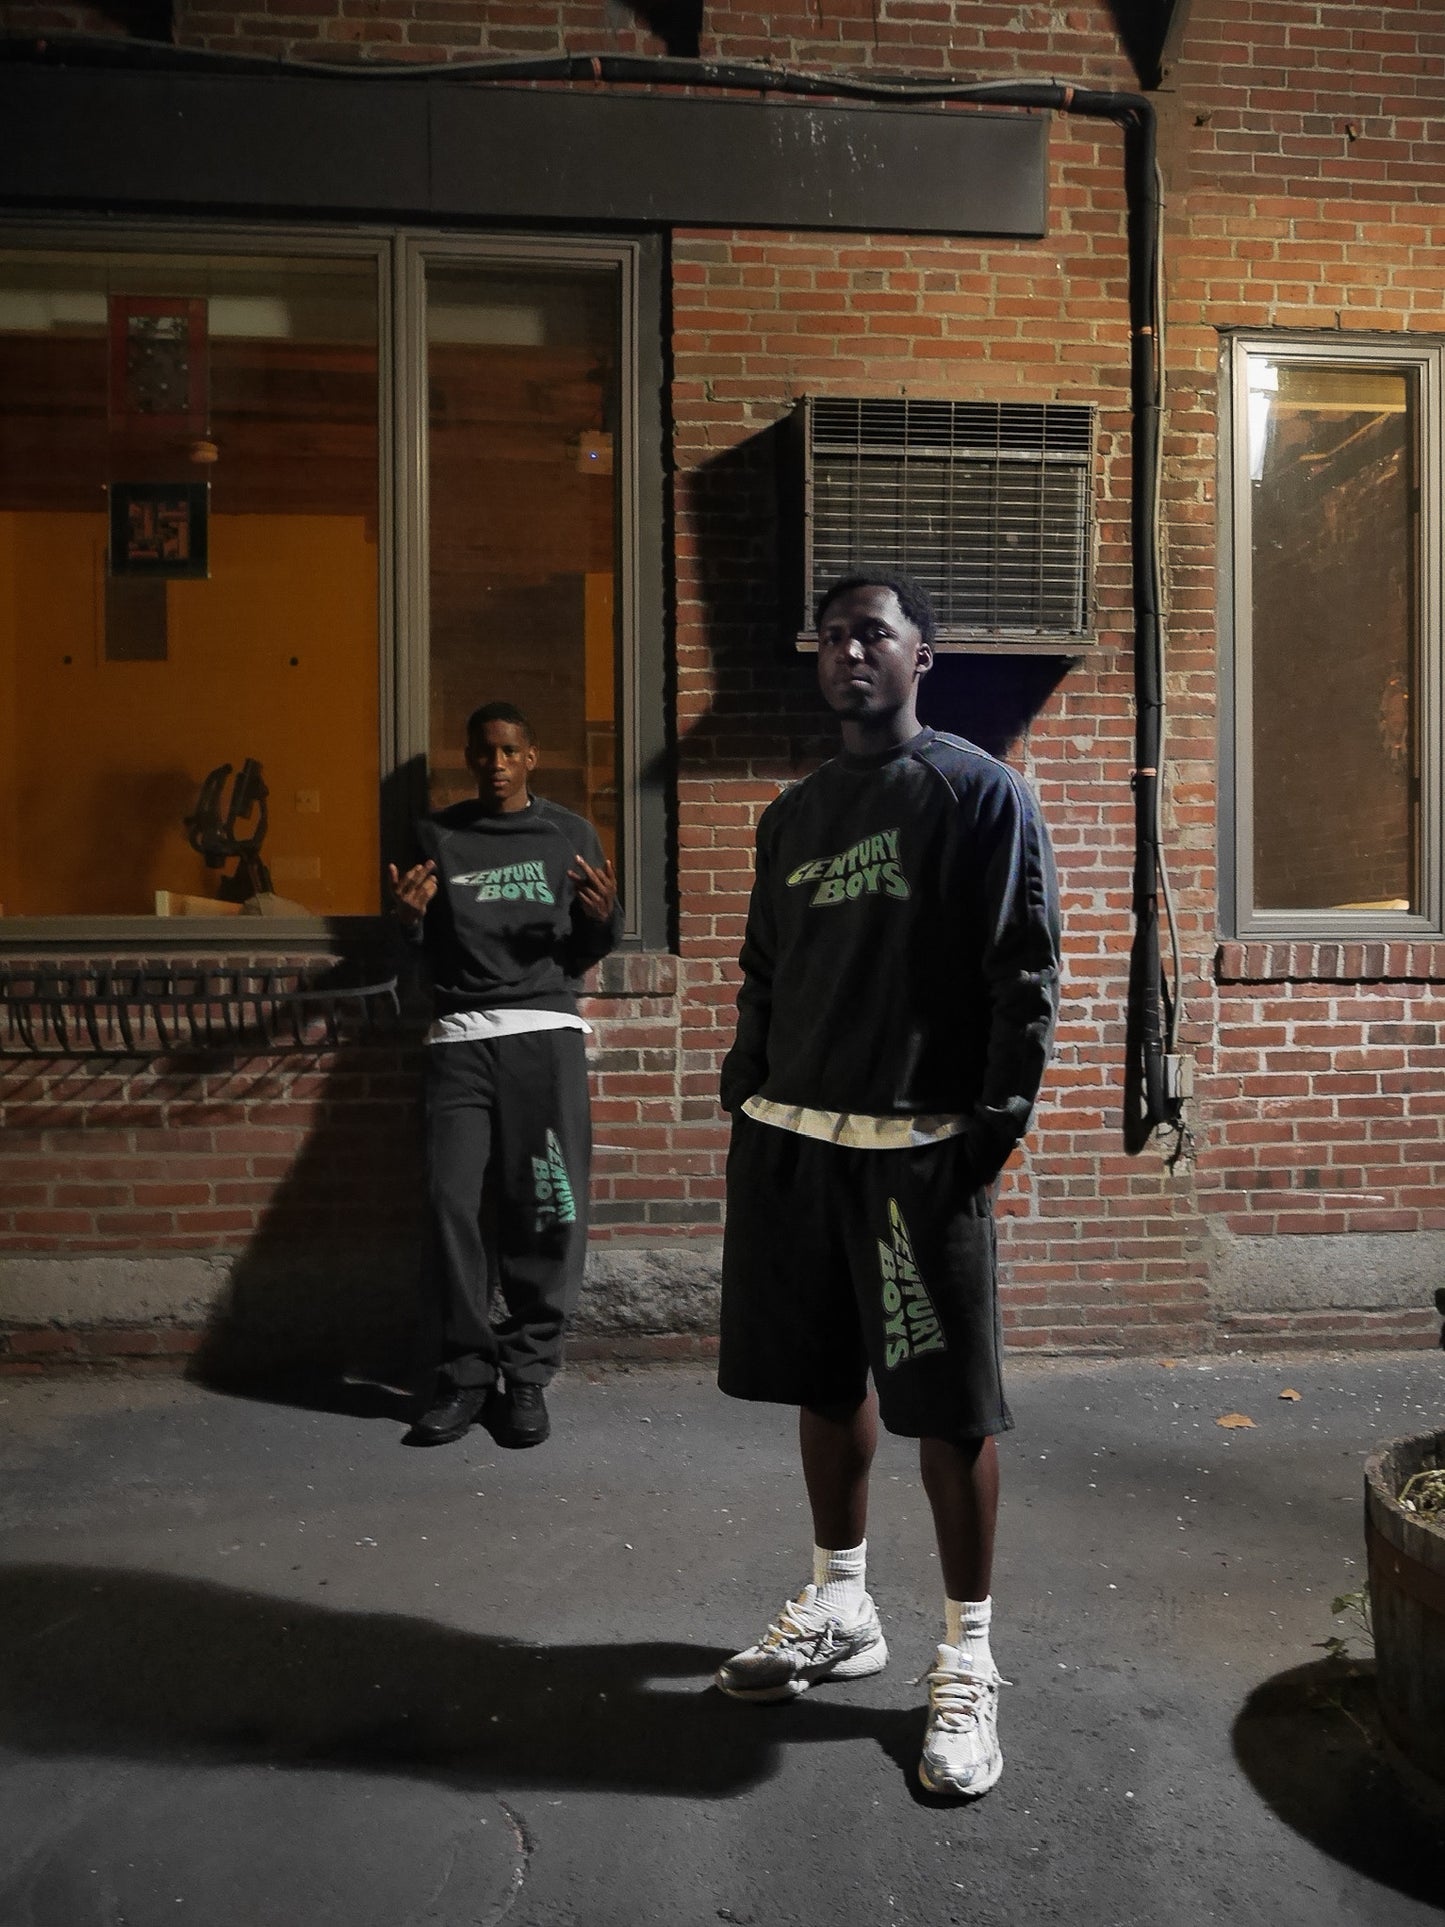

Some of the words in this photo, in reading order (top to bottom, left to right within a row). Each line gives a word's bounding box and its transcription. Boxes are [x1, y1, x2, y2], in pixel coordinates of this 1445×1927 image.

[450, 861, 545, 885] CENTURY
[787, 829, 899, 886] CENTURY
[476, 881, 555, 904] BOYS
[810, 861, 911, 906] BOYS
[889, 1198, 946, 1355] CENTURY
[877, 1239, 910, 1369] BOYS
